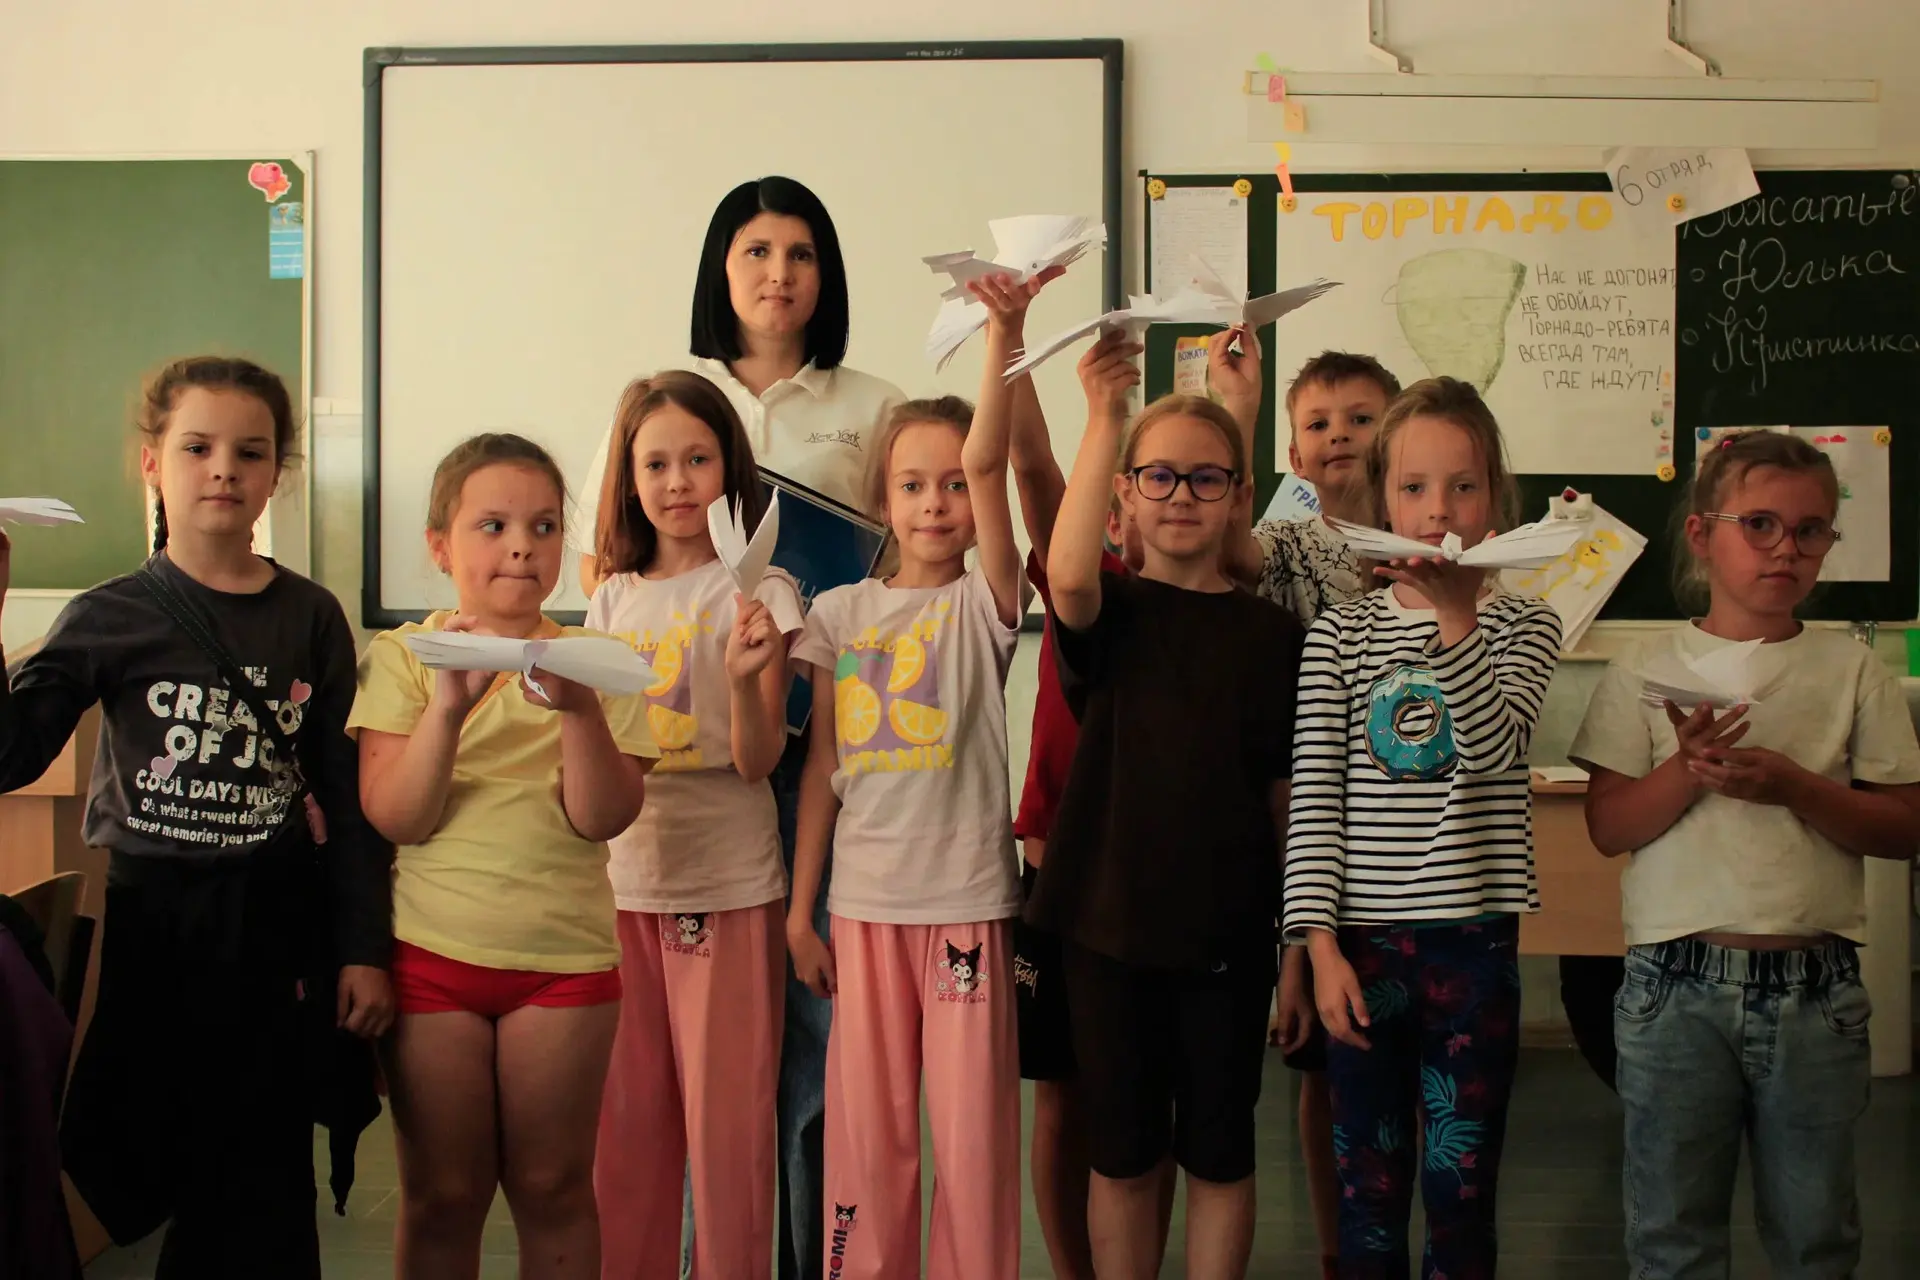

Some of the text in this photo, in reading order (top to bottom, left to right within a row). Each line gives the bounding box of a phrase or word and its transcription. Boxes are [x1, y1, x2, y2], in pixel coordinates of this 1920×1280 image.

[1617, 164, 1644, 206] 6
[1312, 194, 1613, 242] ТОРНАДО
[1719, 238, 1906, 300] Юлька
[1518, 344, 1583, 363] ВСЕГДА
[1543, 370, 1581, 389] ГДЕ
[165, 725, 223, 764] OF
[136, 769, 184, 797] COOL
[189, 778, 241, 803] DAYS
[160, 802, 189, 821] what
[191, 810, 198, 820] a
[127, 815, 268, 848] sweet memories you and
